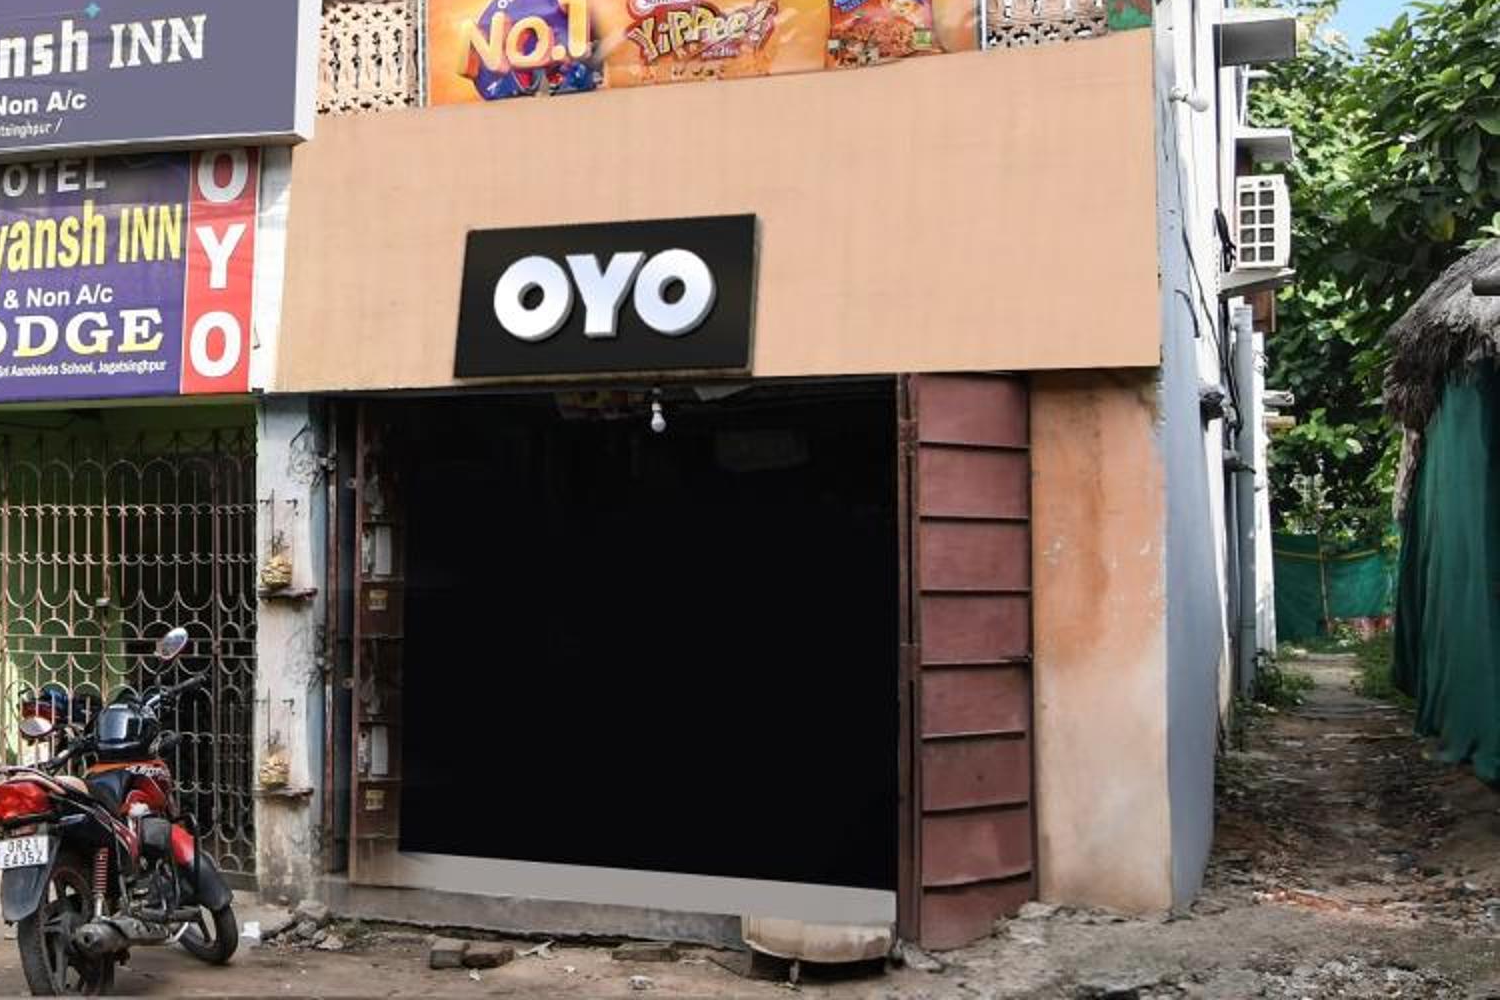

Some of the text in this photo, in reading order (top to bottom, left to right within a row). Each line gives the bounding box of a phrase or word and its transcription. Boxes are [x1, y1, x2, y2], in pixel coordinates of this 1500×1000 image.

[109, 14, 207, 69] INN
[47, 89, 87, 112] A/c
[117, 203, 183, 264] INN
[190, 150, 249, 377] OYO
[3, 289, 19, 310] &
[26, 286, 70, 308] Non
[76, 283, 113, 305] A/c
[494, 248, 716, 342] OYO
